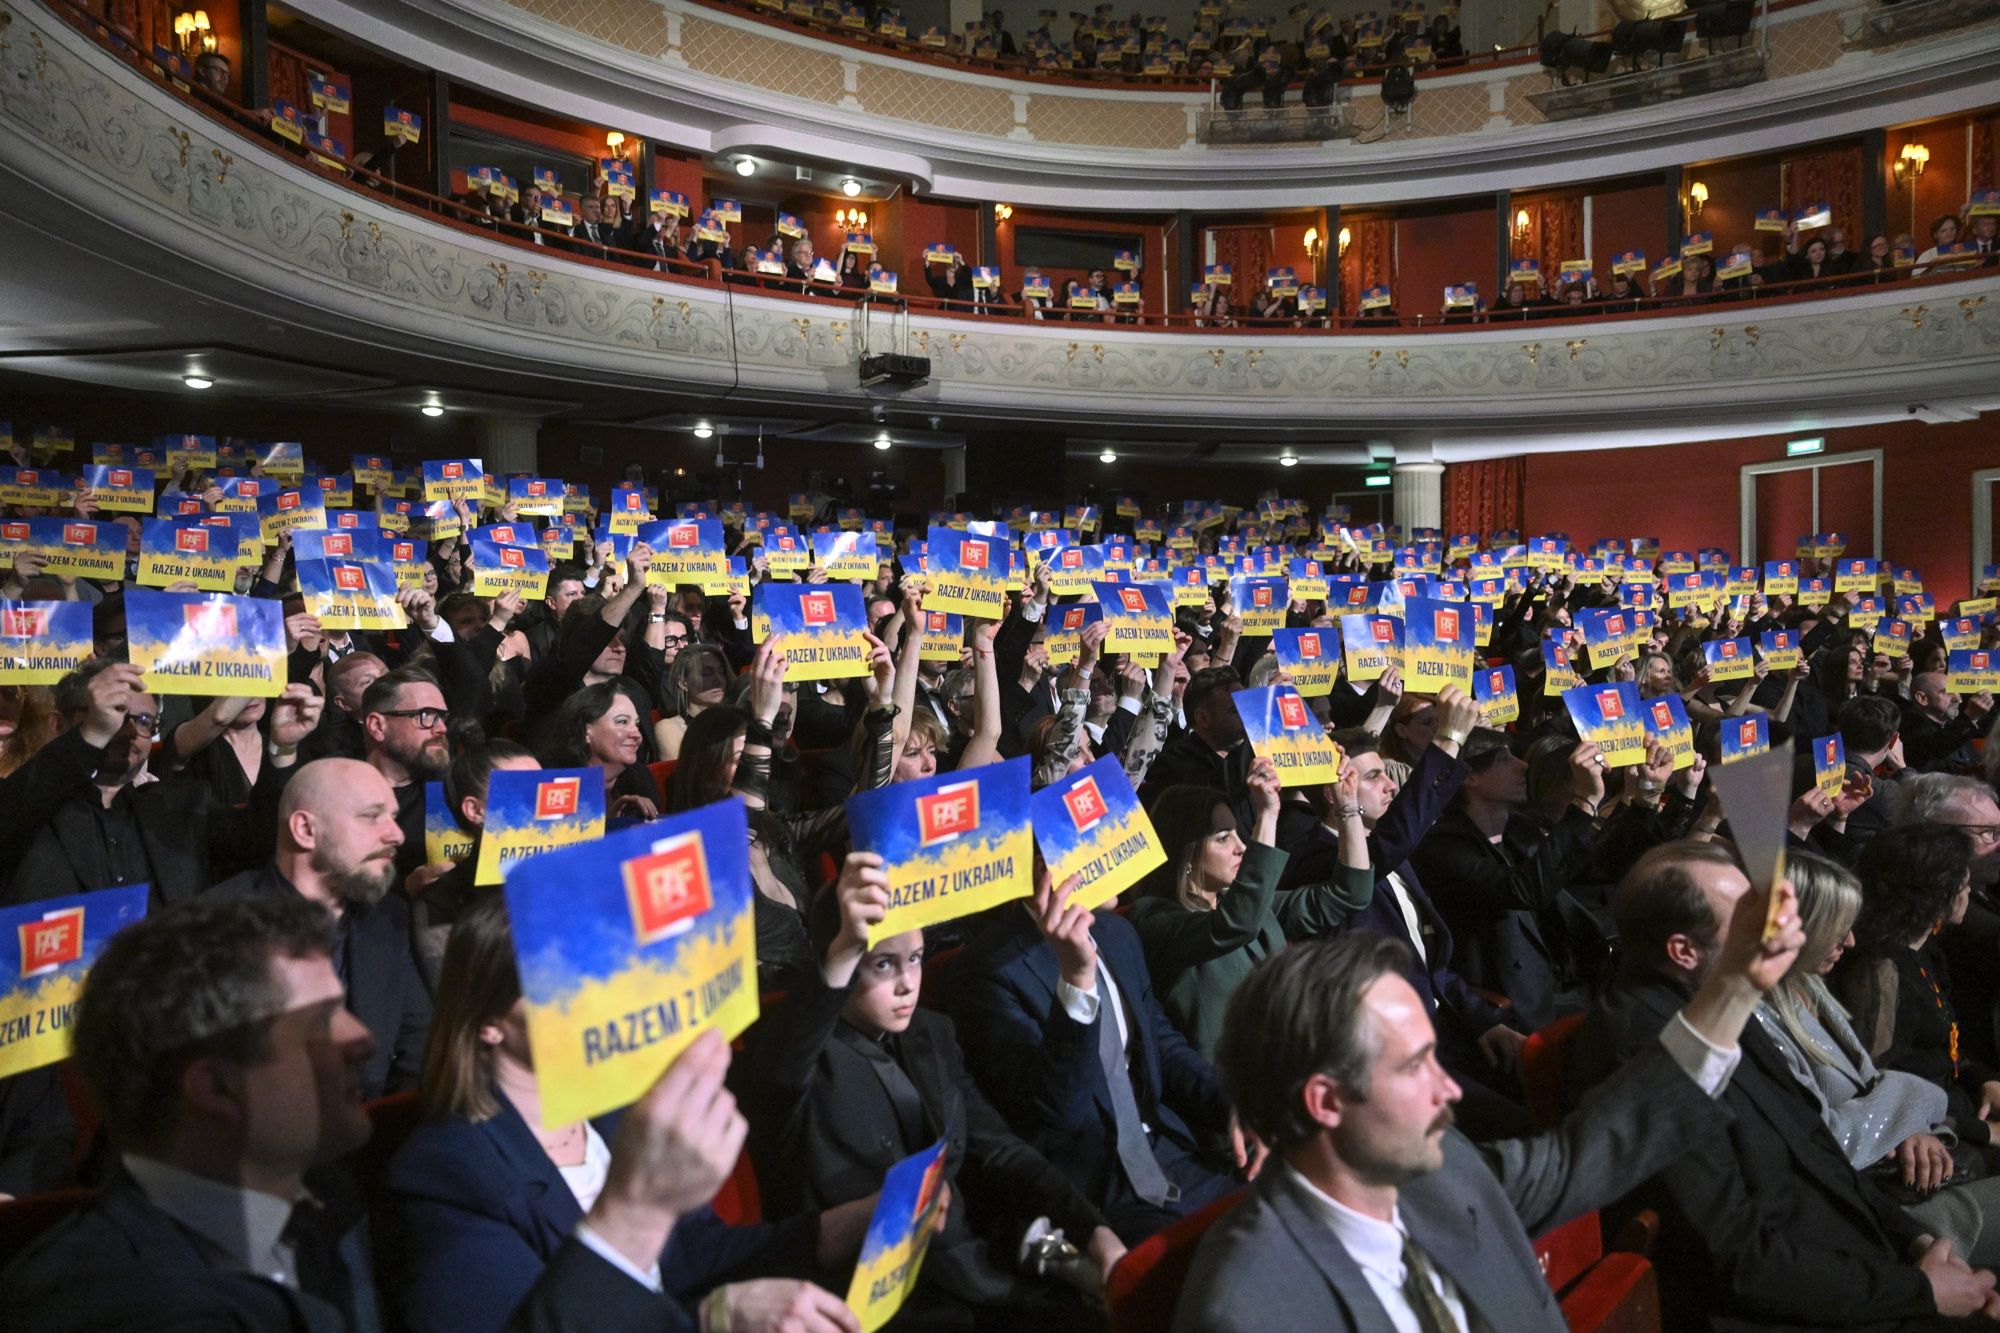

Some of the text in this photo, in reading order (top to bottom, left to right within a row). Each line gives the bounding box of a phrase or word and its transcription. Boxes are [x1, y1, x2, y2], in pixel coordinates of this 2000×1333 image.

[72, 558, 76, 566] Z
[78, 558, 114, 571] UKRAINĄ
[152, 564, 226, 579] RAZEM Z UKRAINĄ
[651, 562, 718, 574] RAZEM Z UKRAINĄ
[484, 577, 509, 588] RAZEM
[510, 580, 514, 588] Z
[938, 584, 1001, 607] RAZEM Z UKRAINĄ
[320, 606, 350, 617] RAZEM
[1116, 628, 1170, 642] RAZEM Z UKRAINĄ
[18, 657, 26, 670] Z
[786, 646, 862, 664] RAZEM Z UKRAINĄ
[1358, 656, 1384, 668] RAZEM
[1386, 656, 1390, 666] Z
[204, 662, 212, 676] Z
[216, 662, 272, 682] UKRAINĄ
[1417, 661, 1444, 676] RAZEM
[1446, 664, 1450, 677] Z
[1272, 750, 1333, 768] RAZEM Z UKRAINĄ
[547, 788, 571, 806] PAF
[933, 798, 967, 824] PAF
[1104, 853, 1113, 872] Z
[1110, 831, 1150, 866] UKRAINĄ
[645, 856, 696, 908] PAF
[940, 874, 949, 896] Z
[953, 855, 1014, 892] UKRAINĄ
[36, 1010, 46, 1036] Z
[582, 997, 682, 1066] RAZEM
[686, 991, 700, 1026] Z
